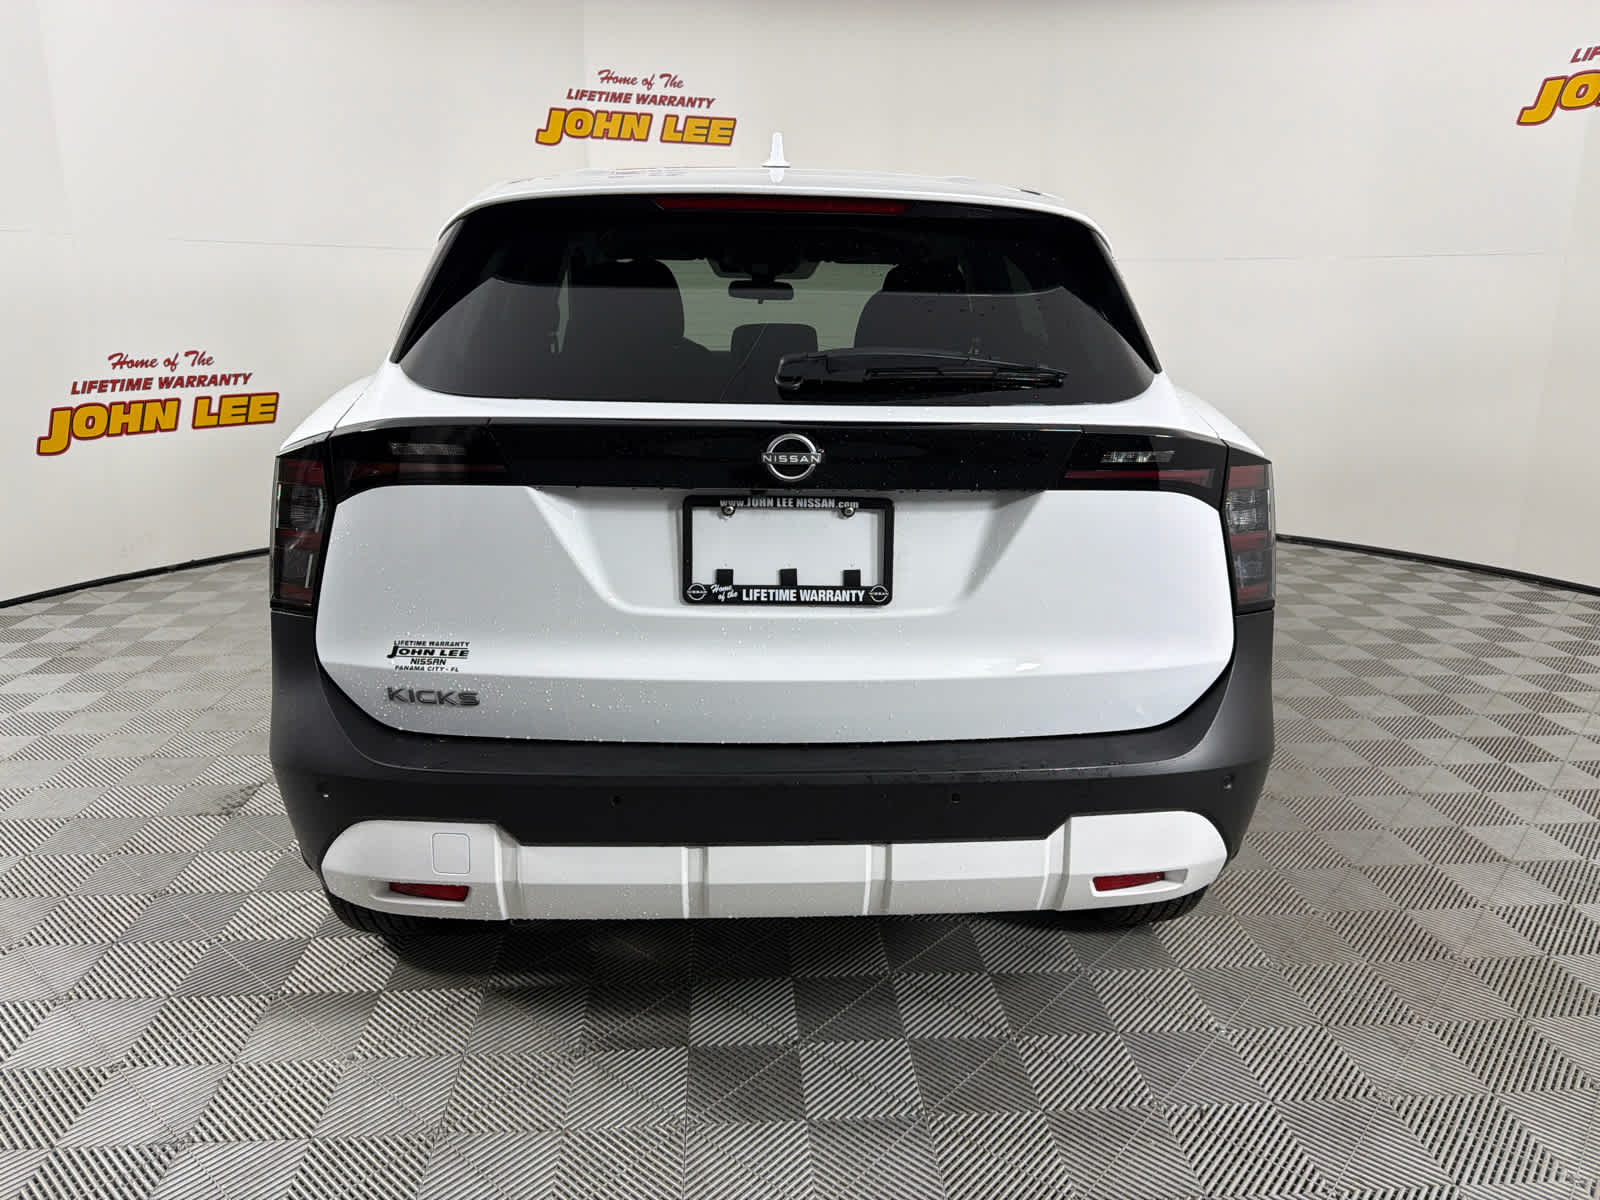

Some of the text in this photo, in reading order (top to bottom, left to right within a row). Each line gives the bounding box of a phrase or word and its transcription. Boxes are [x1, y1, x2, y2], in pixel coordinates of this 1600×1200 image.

[597, 69, 684, 91] Home of The
[566, 88, 716, 109] LIFETIME WARRANTY
[535, 107, 737, 146] JOHN LEE
[107, 350, 215, 372] Home of The
[70, 372, 253, 395] LIFETIME WARRANTY
[36, 392, 280, 456] JOHN LEE
[762, 454, 821, 464] NISSAN
[776, 498, 794, 508] LEE
[710, 584, 733, 594] Home
[742, 588, 797, 602] LIFETIME
[799, 589, 865, 603] WARRANTY
[387, 645, 470, 659] JOHN LEE
[386, 687, 481, 707] KICKS
